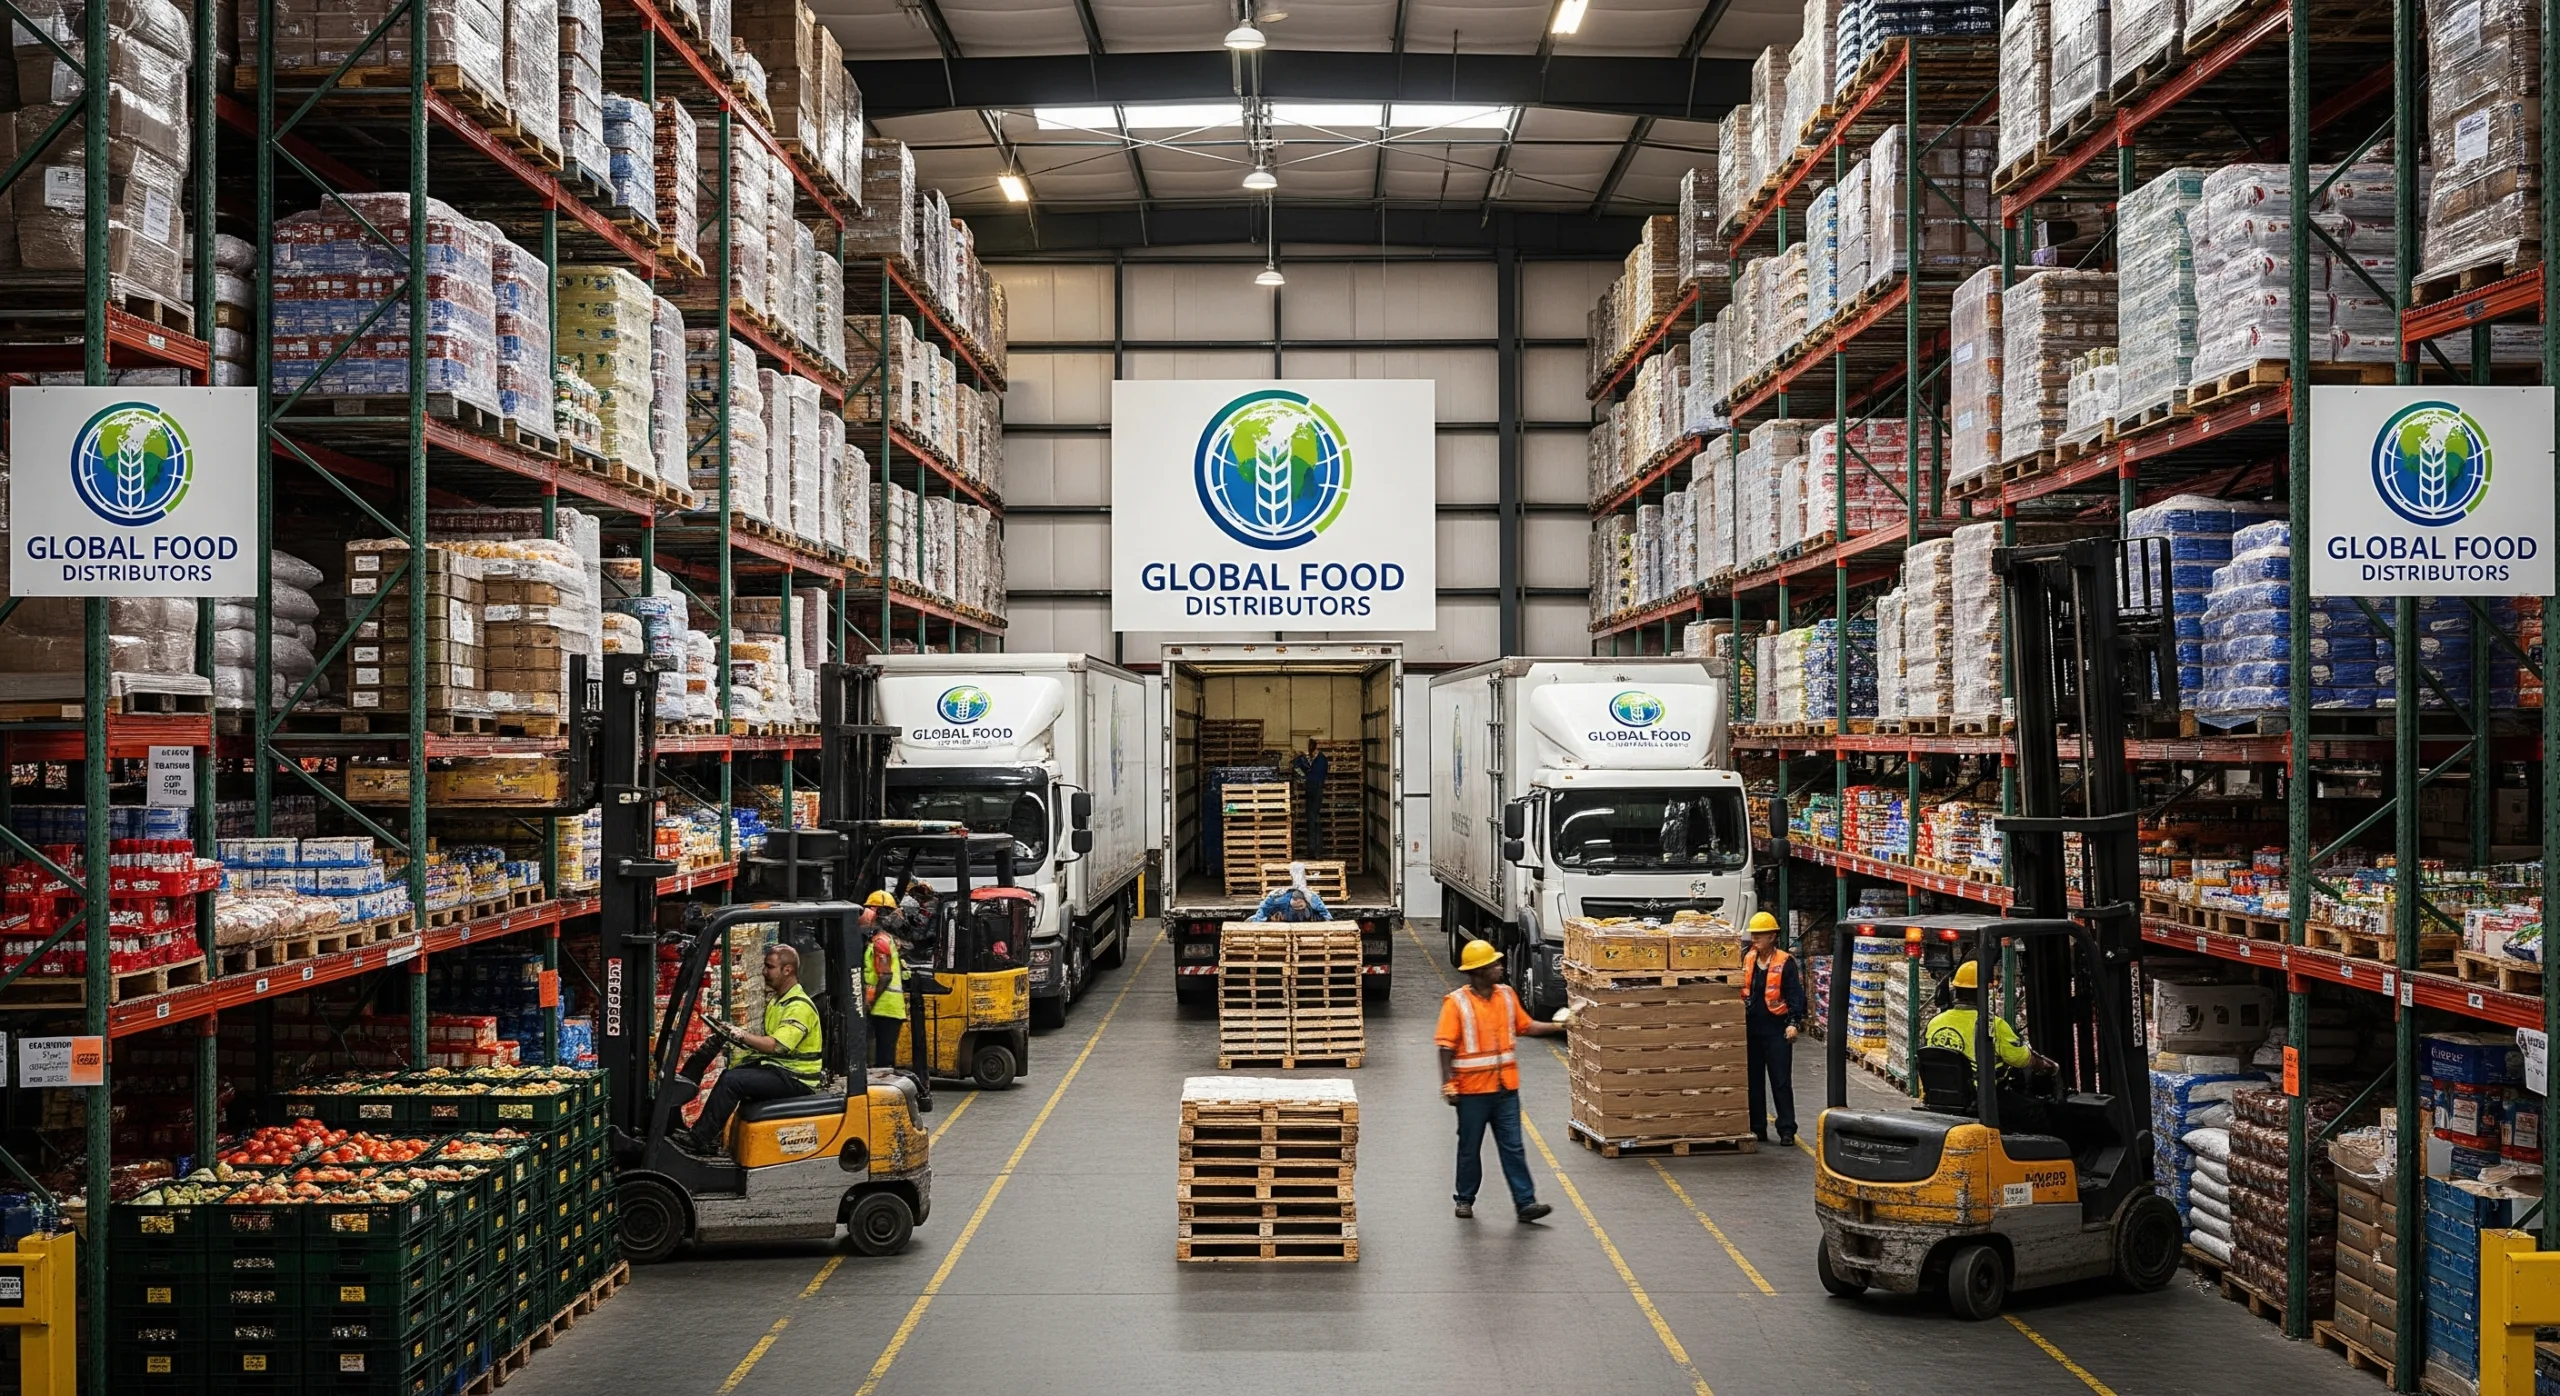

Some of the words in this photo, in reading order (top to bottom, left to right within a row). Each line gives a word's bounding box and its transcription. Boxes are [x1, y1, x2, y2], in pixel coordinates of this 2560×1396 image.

[27, 536, 145, 560] GLOBAL
[154, 536, 238, 560] FOOD
[2327, 536, 2447, 560] GLOBAL
[2455, 536, 2538, 560] FOOD
[62, 564, 212, 582] DISTRIBUTORS
[1141, 562, 1290, 592] GLOBAL
[1300, 562, 1405, 592] FOOD
[2362, 564, 2510, 582] DISTRIBUTORS
[1186, 596, 1371, 616] DISTRIBUTORS
[912, 728, 970, 740] GLOBAL
[972, 727, 1013, 739] FOOD
[1588, 730, 1649, 742] GLOBAL
[1651, 730, 1691, 742] FOOD
